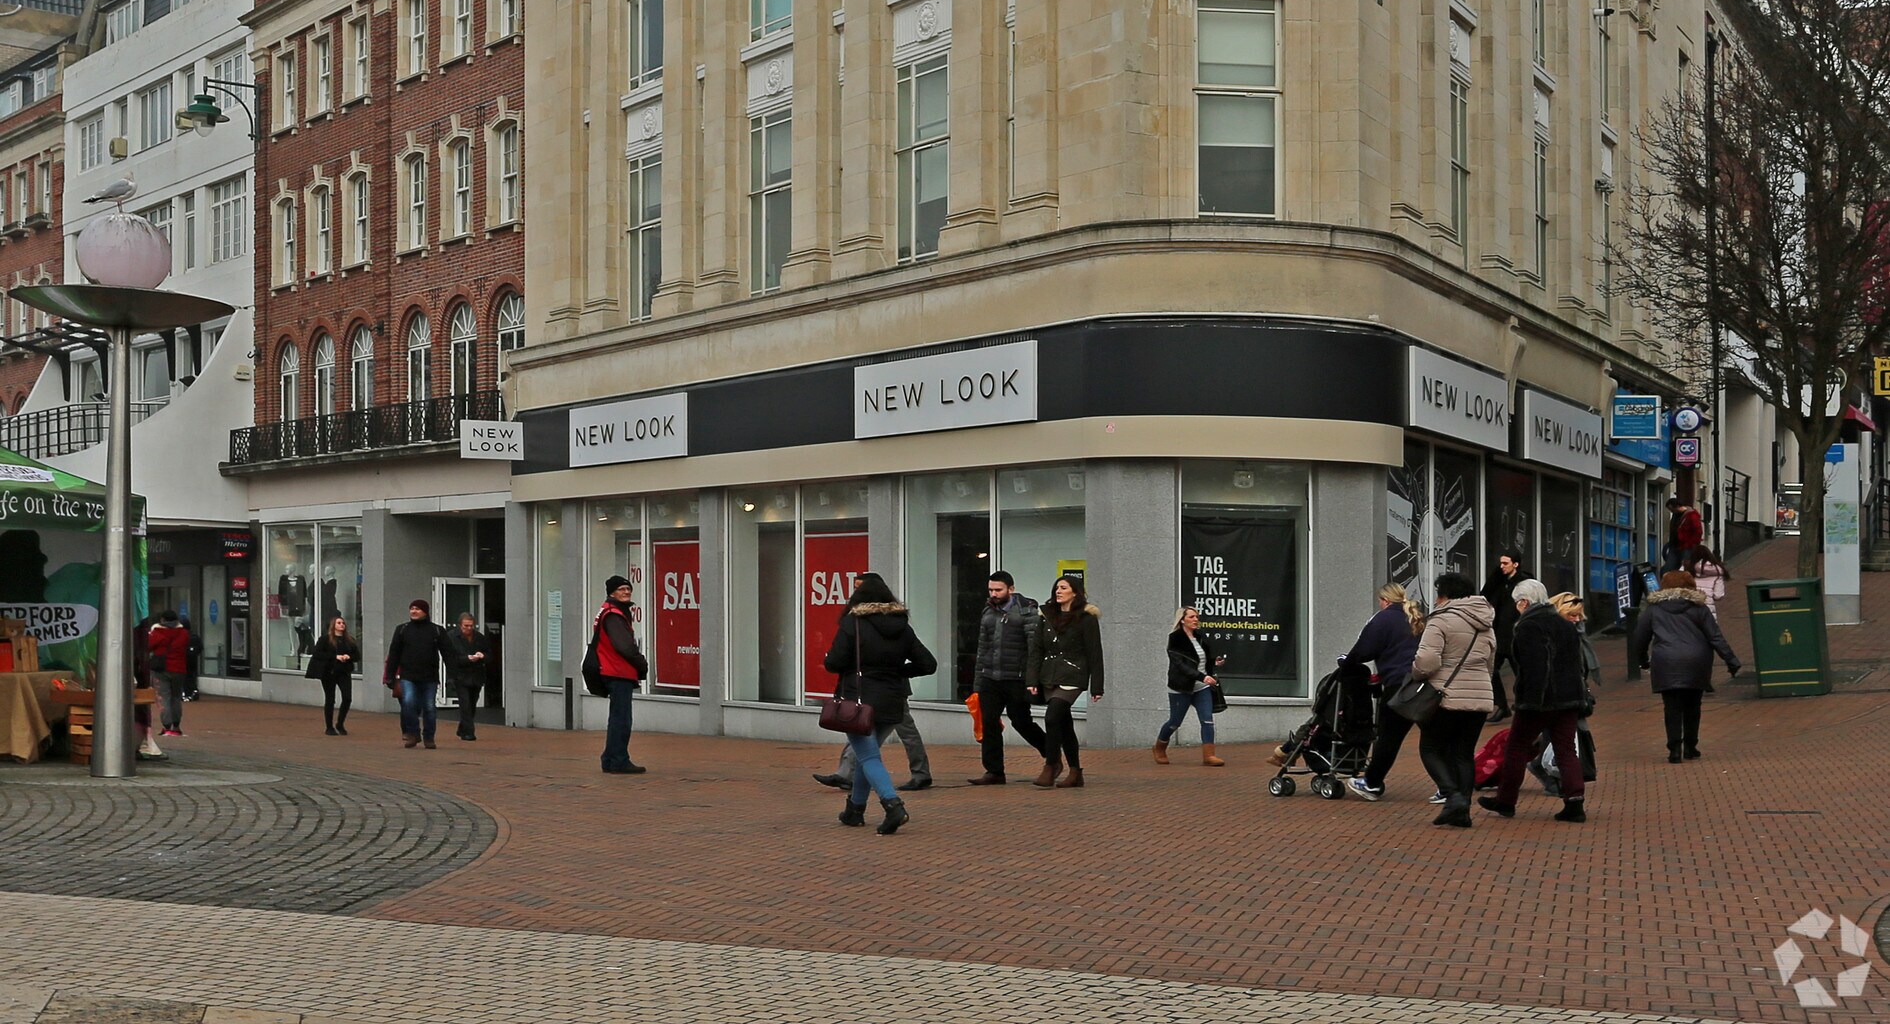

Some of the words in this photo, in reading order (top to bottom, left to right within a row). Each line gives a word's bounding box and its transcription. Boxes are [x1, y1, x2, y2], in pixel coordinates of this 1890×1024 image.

[864, 382, 924, 413] NEW
[940, 369, 1019, 404] LOOK
[1422, 376, 1457, 411] NEW
[1465, 391, 1504, 426] LOOK
[473, 428, 514, 439] NEW
[575, 423, 615, 447] NEW
[624, 415, 675, 441] LOOK
[1535, 415, 1563, 445] NEW
[1569, 427, 1599, 456] LOOK
[469, 441, 518, 453] LOOK
[24, 496, 46, 515] on
[52, 493, 80, 517] the
[1194, 556, 1228, 574] TAG.
[1421, 545, 1443, 565] MRE
[663, 572, 700, 610] SA
[1194, 577, 1232, 595] LIKE.
[1194, 597, 1261, 617] #SHARE.
[1198, 621, 1280, 630] newlookfashion
[676, 643, 700, 655] newloo
